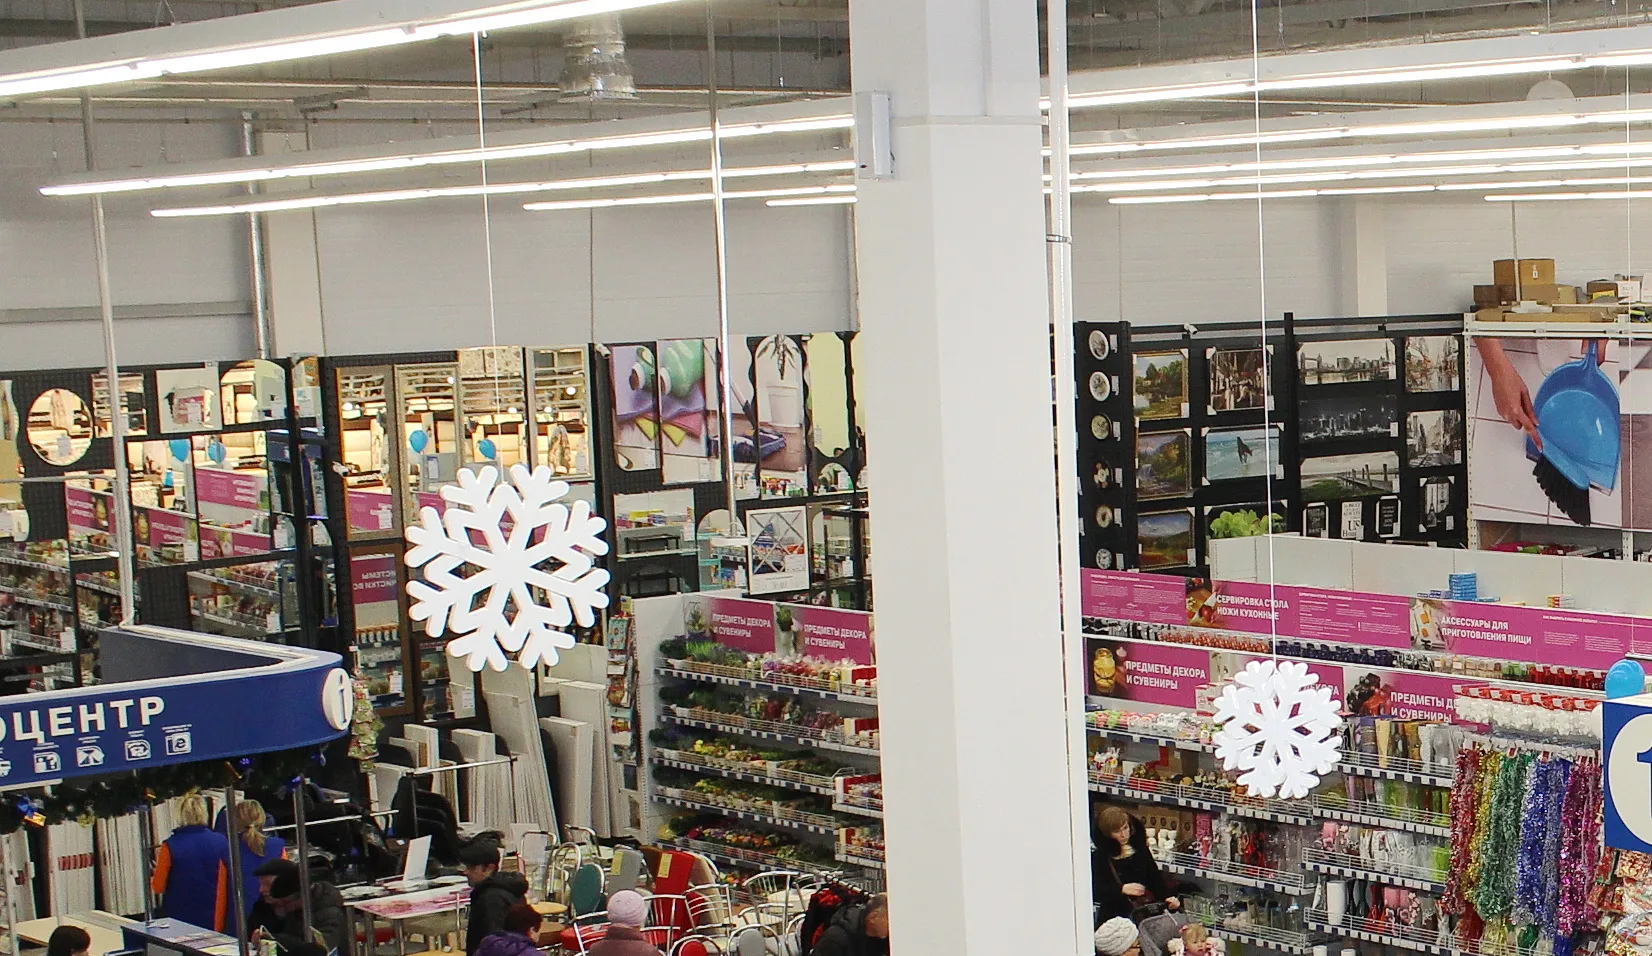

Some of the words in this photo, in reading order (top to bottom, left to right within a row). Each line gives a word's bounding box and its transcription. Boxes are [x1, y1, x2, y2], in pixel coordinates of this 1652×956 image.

[1217, 595, 1263, 607] СЕРВИРОВКА
[1264, 598, 1289, 609] СТОЛА
[712, 613, 746, 625] ПРЕДМЕТЫ
[747, 617, 771, 629] ДЕКОРА
[1217, 606, 1238, 616] НОЖИ
[1239, 608, 1279, 620] КУХОННЫЕ
[1441, 616, 1490, 629] АКСЕССУАРЫ
[1492, 620, 1508, 631] ДЛЯ
[719, 627, 751, 638] СУВЕНИРЫ
[804, 624, 840, 637] ПРЕДМЕТЫ
[841, 629, 867, 640] ДЕКОРА
[1441, 627, 1506, 643] ПРИГОТОВЛЕНИЯ
[1507, 633, 1532, 646] ПИЩИ
[811, 638, 845, 649] СУВЕНИРЫ
[1126, 660, 1170, 676] ПРЕДМЕТЫ
[1172, 665, 1206, 679] ДЕКОРА
[1126, 673, 1132, 684] И
[1133, 674, 1178, 690] СУВЕНИРЫ
[1391, 692, 1444, 707] ПРЕДМЕТЫ
[0, 696, 164, 744] ЦЕНТР
[1391, 707, 1397, 716] И
[1400, 708, 1451, 723] СУВЕНИРЫ
